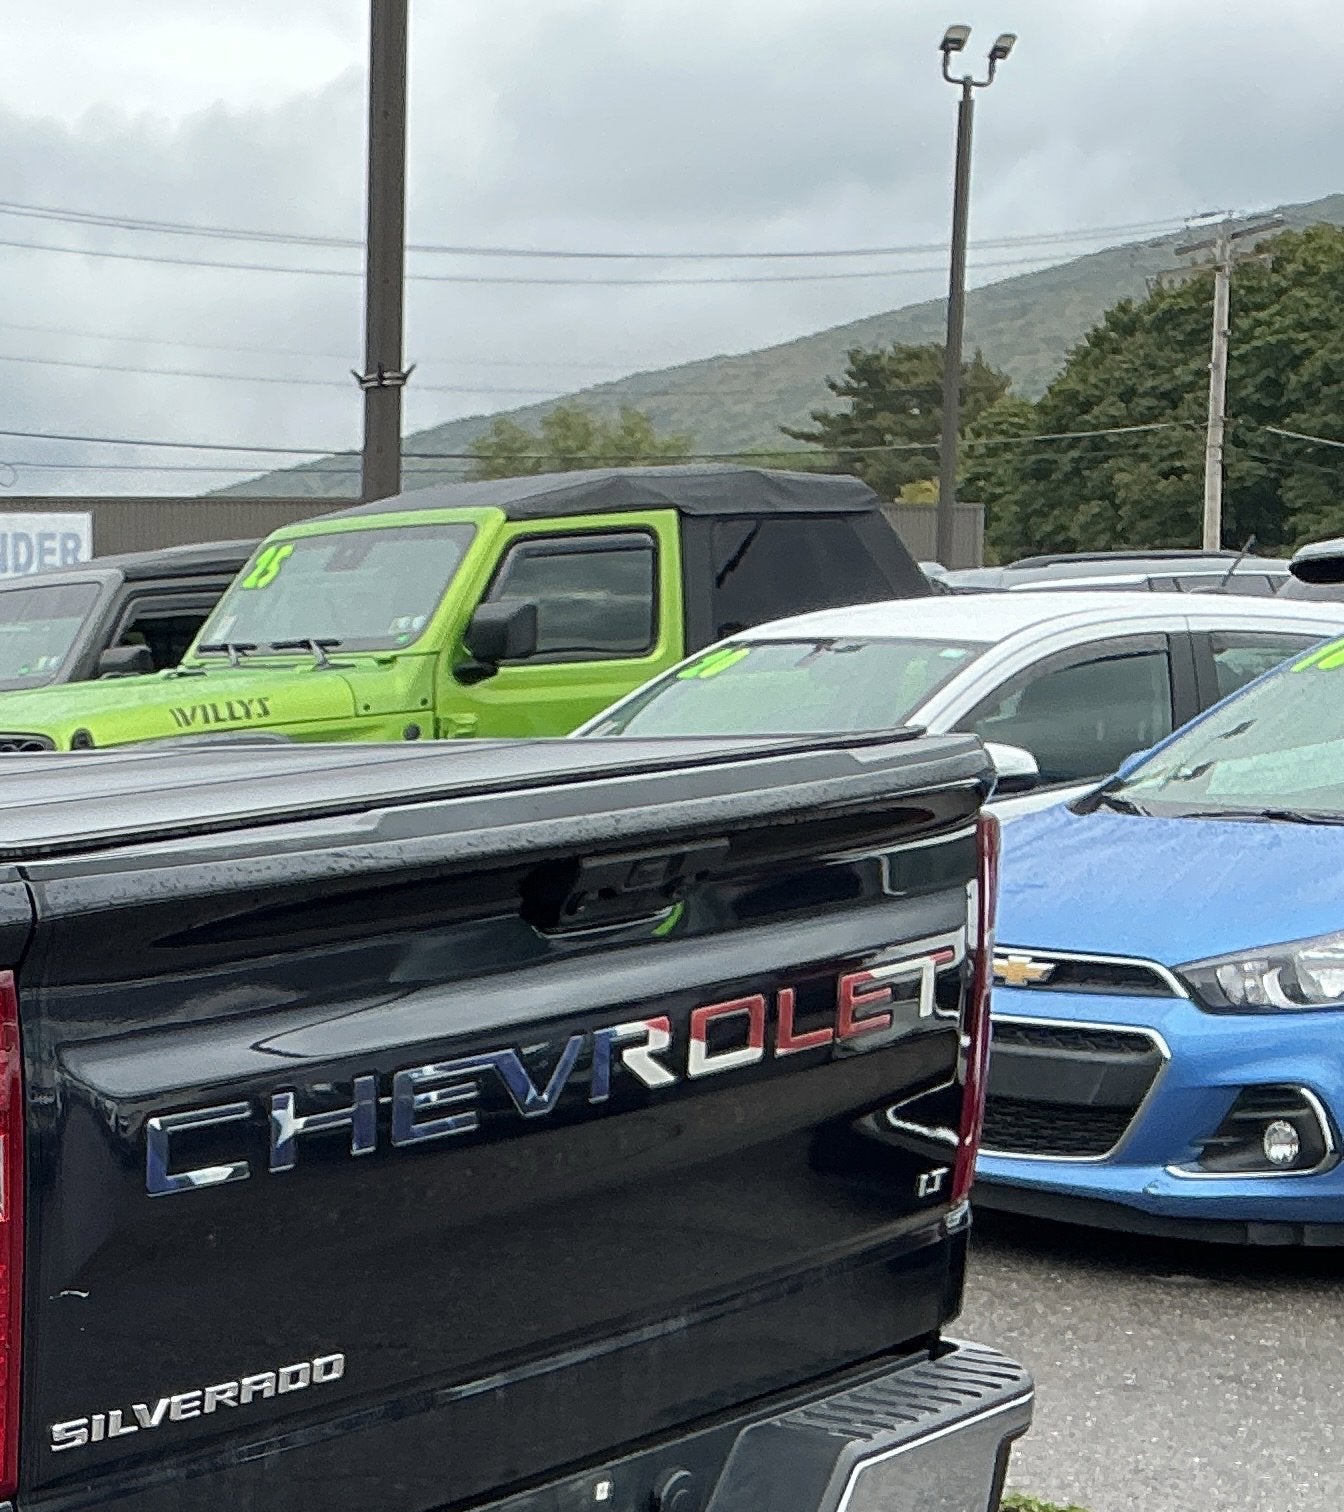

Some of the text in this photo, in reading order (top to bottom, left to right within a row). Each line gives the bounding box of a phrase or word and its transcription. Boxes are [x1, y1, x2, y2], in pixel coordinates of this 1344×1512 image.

[169, 697, 271, 728] WILLYS
[147, 950, 954, 1197] CHEVROLET
[917, 1167, 951, 1197] LT
[50, 1353, 345, 1452] SILVERADO
